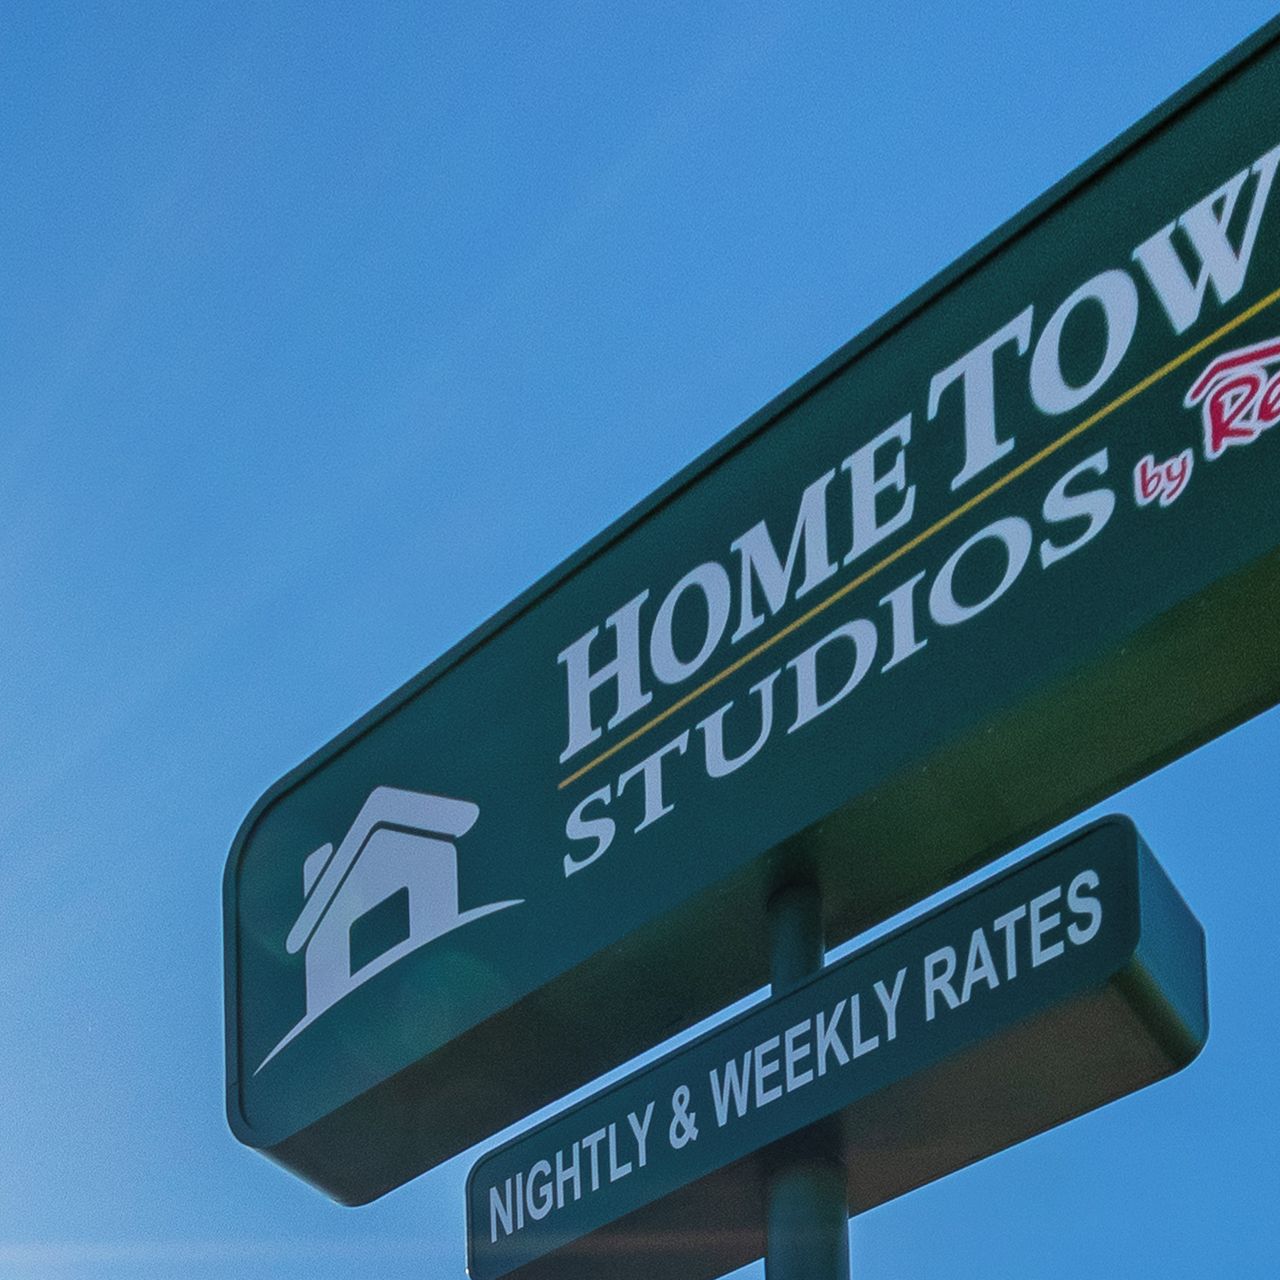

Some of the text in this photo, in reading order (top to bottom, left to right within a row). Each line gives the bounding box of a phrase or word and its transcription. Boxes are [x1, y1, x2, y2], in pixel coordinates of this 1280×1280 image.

[563, 447, 1116, 878] STUDIOS
[1134, 449, 1193, 507] by
[487, 869, 1102, 1243] NIGHTLY & WEEKLY RATES
